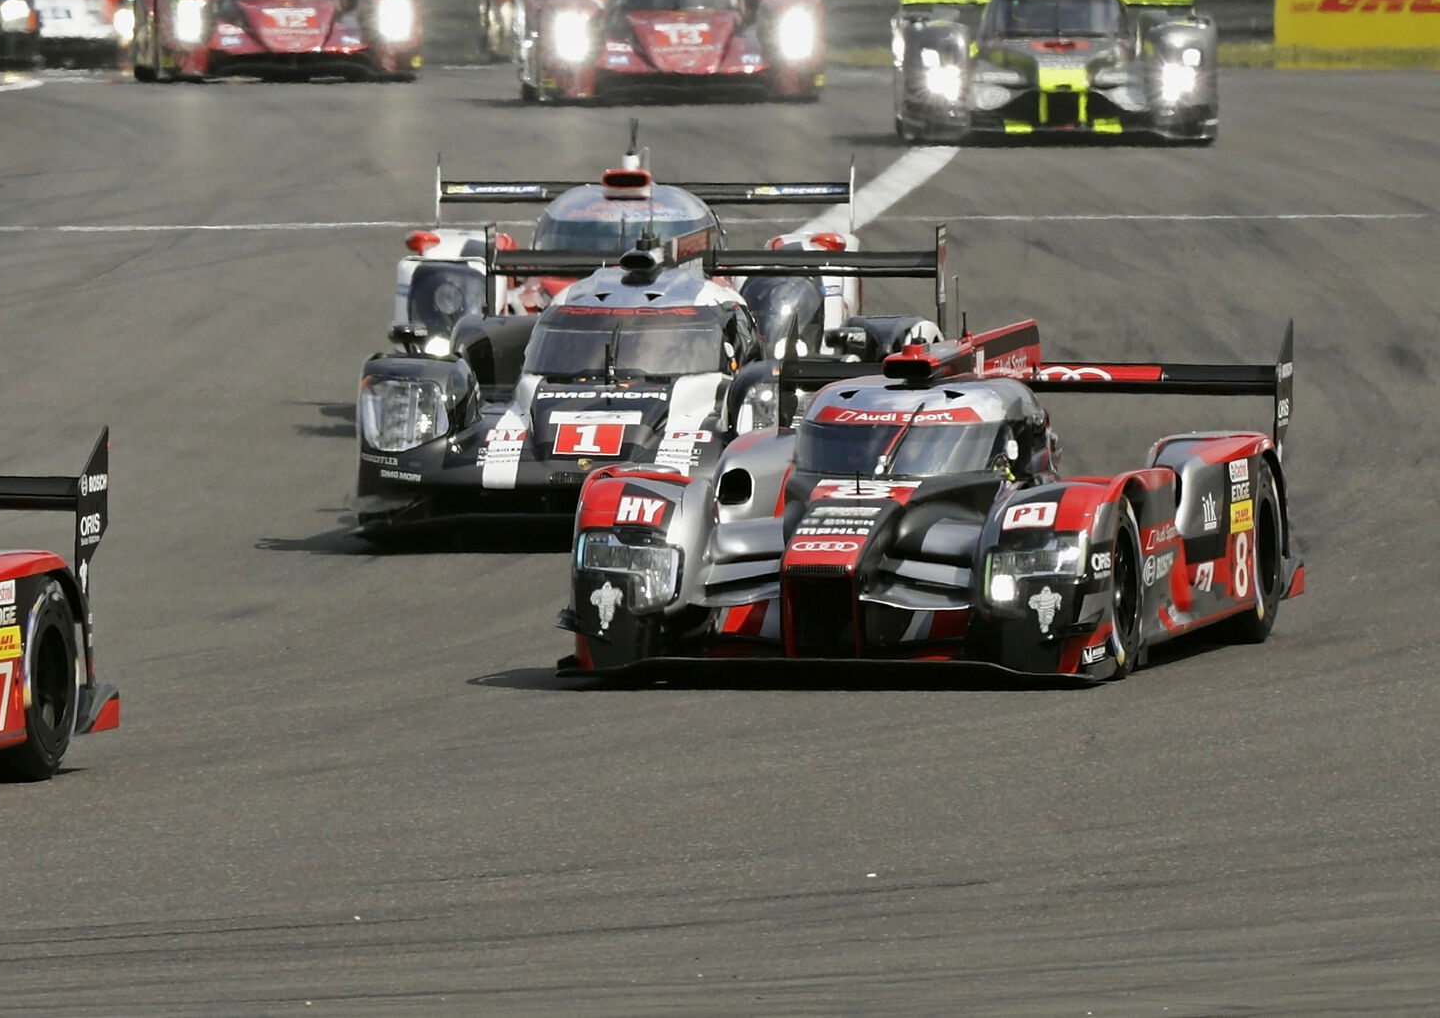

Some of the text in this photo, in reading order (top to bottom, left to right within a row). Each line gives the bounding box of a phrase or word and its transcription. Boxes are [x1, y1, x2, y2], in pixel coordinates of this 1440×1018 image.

[557, 306, 698, 316] PORSCHE
[537, 391, 668, 401] DMG MORI
[854, 412, 953, 423] Audi Sport
[486, 429, 525, 441] HY
[573, 425, 601, 452] 1
[673, 432, 703, 440] P1
[89, 474, 107, 493] BOSCH
[829, 486, 892, 499] 8
[1231, 482, 1250, 503] EDGE
[616, 496, 665, 522] HY
[1013, 507, 1047, 522] P1
[80, 513, 100, 536] ORIS
[796, 527, 870, 535] MAHLE
[1091, 552, 1111, 571] ORIS
[1235, 532, 1248, 597] 8
